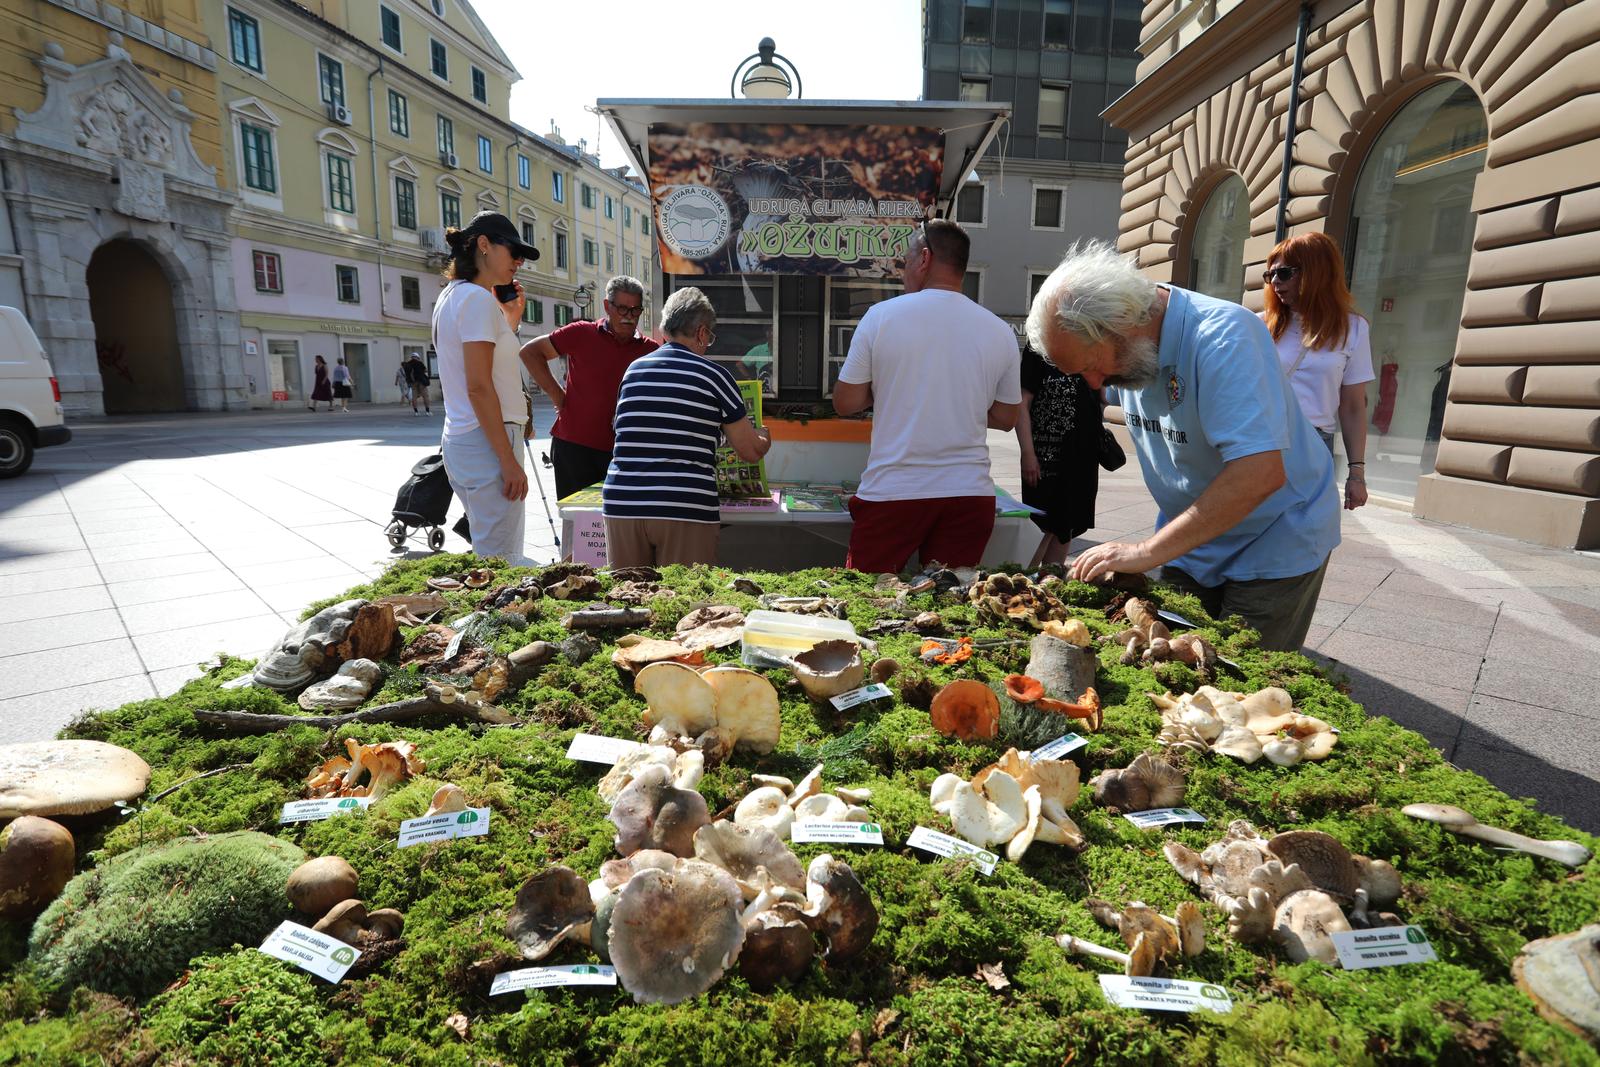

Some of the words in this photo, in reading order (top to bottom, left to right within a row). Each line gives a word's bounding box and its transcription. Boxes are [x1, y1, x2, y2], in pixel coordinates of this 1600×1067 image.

[664, 187, 696, 211] GLJIVARA
[749, 198, 811, 215] UDRUGA
[812, 197, 877, 217] GLJIVARA
[878, 199, 923, 218] RIJEKA
[662, 213, 676, 245] UDRUGA
[711, 219, 728, 246] RIJEKA
[335, 949, 351, 962] ne
[1130, 979, 1162, 989] Amanita
[1163, 983, 1189, 991] citrina
[1204, 987, 1222, 998] ne
